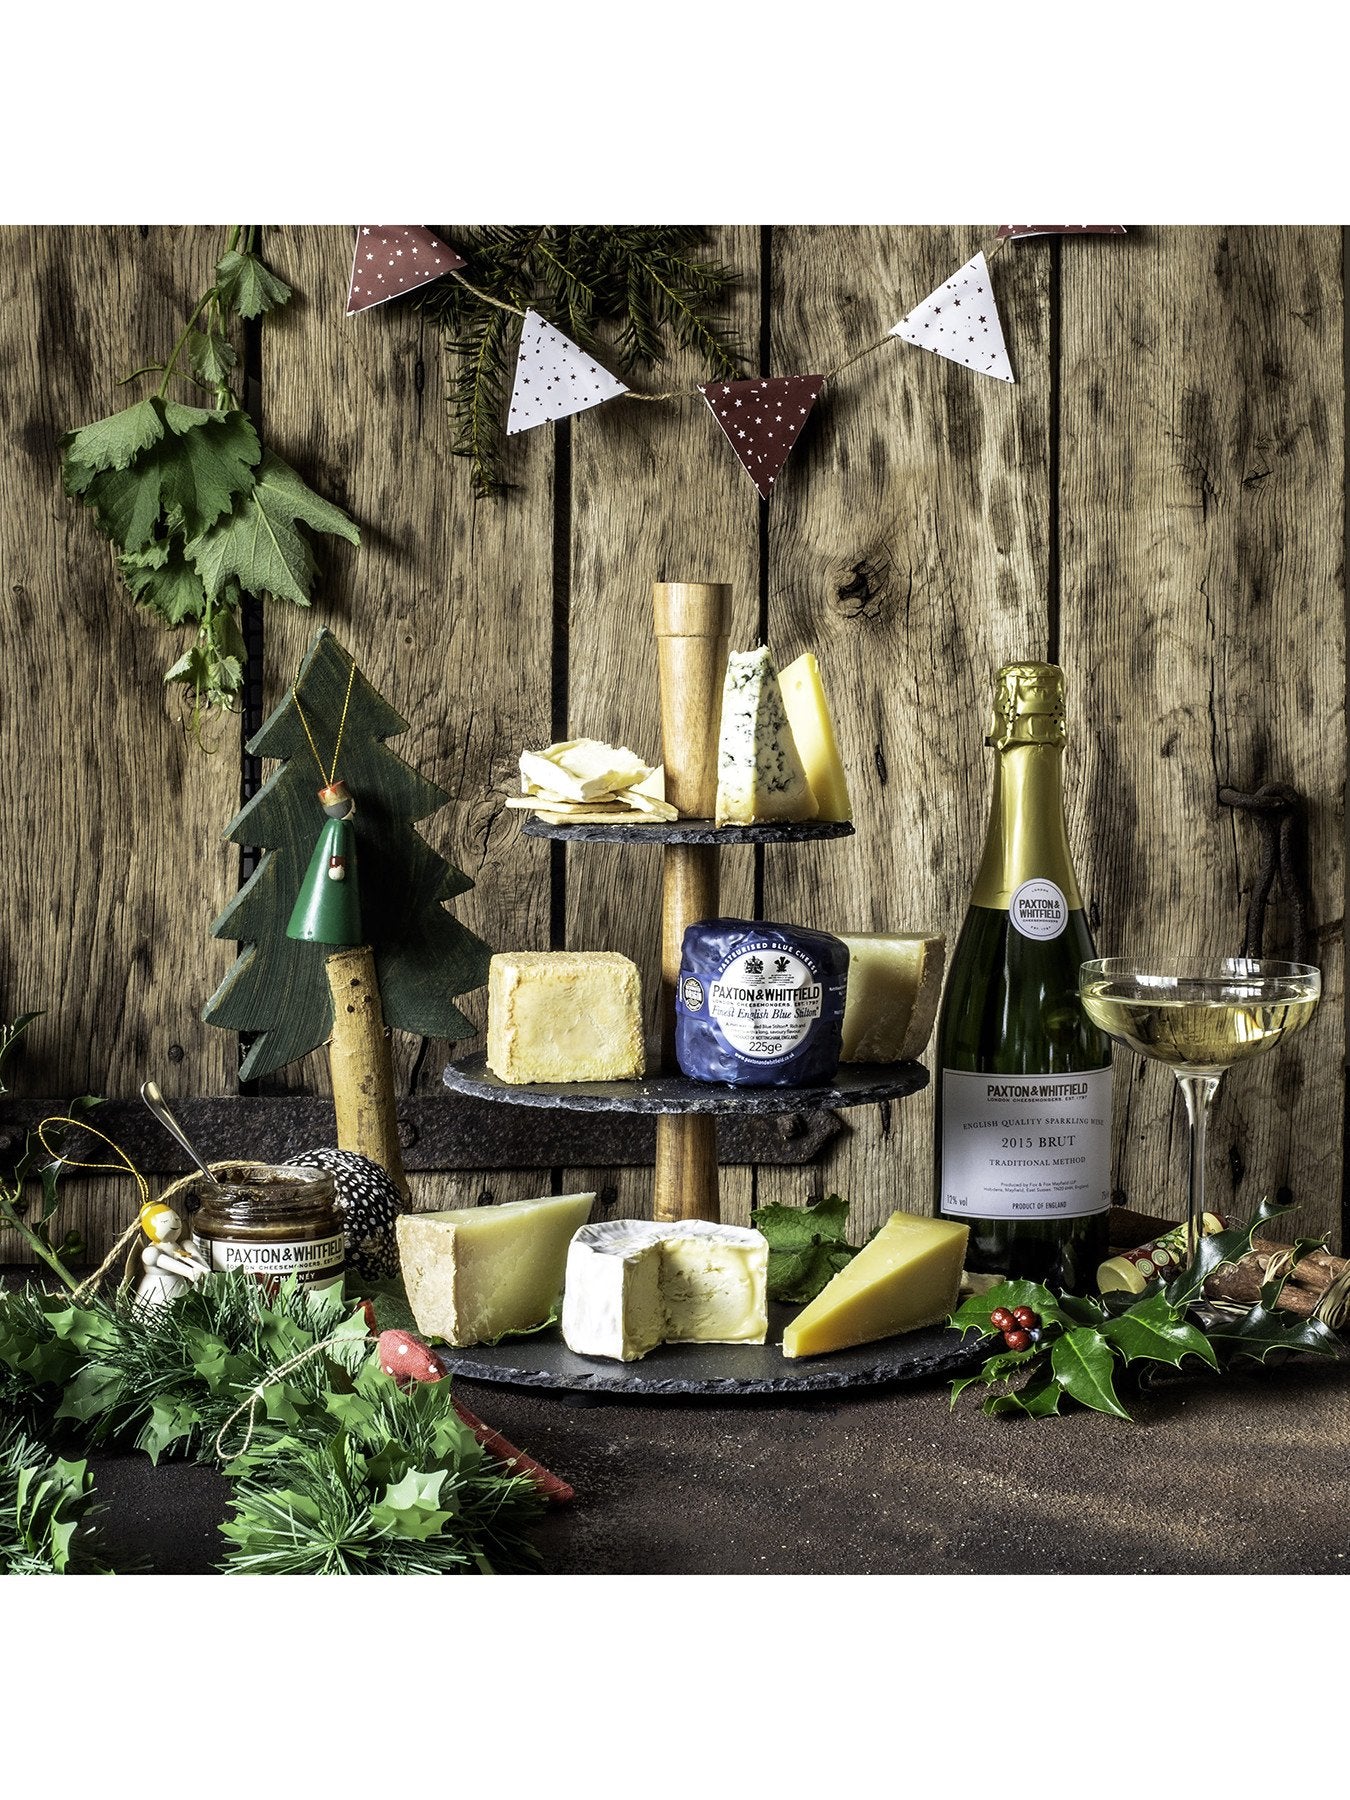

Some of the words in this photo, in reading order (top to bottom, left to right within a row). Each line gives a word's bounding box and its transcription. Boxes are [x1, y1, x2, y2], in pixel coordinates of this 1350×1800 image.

[1019, 909, 1061, 919] WHITFIELD
[718, 942, 768, 973] PASTEURISED
[771, 942, 793, 953] BLUE
[795, 950, 818, 975] CHEESE
[737, 1008, 768, 1020] English
[771, 1009, 792, 1019] Blue
[963, 1120, 998, 1131] ENGLISH
[1001, 1118, 1042, 1128] QUALITY
[1045, 1117, 1089, 1126] SPARKLING
[1090, 1118, 1104, 1126] WINE
[1001, 1137, 1033, 1149] 2015
[1039, 1135, 1077, 1148] BRUT
[989, 1159, 1051, 1167] TRADITIONAL
[1052, 1156, 1086, 1166] METHOD
[946, 1194, 957, 1205] 12%
[959, 1196, 968, 1206] vol
[1012, 1202, 1035, 1210] PRODUCT
[1036, 1202, 1044, 1210] OF
[1045, 1201, 1067, 1210] ENGLAND
